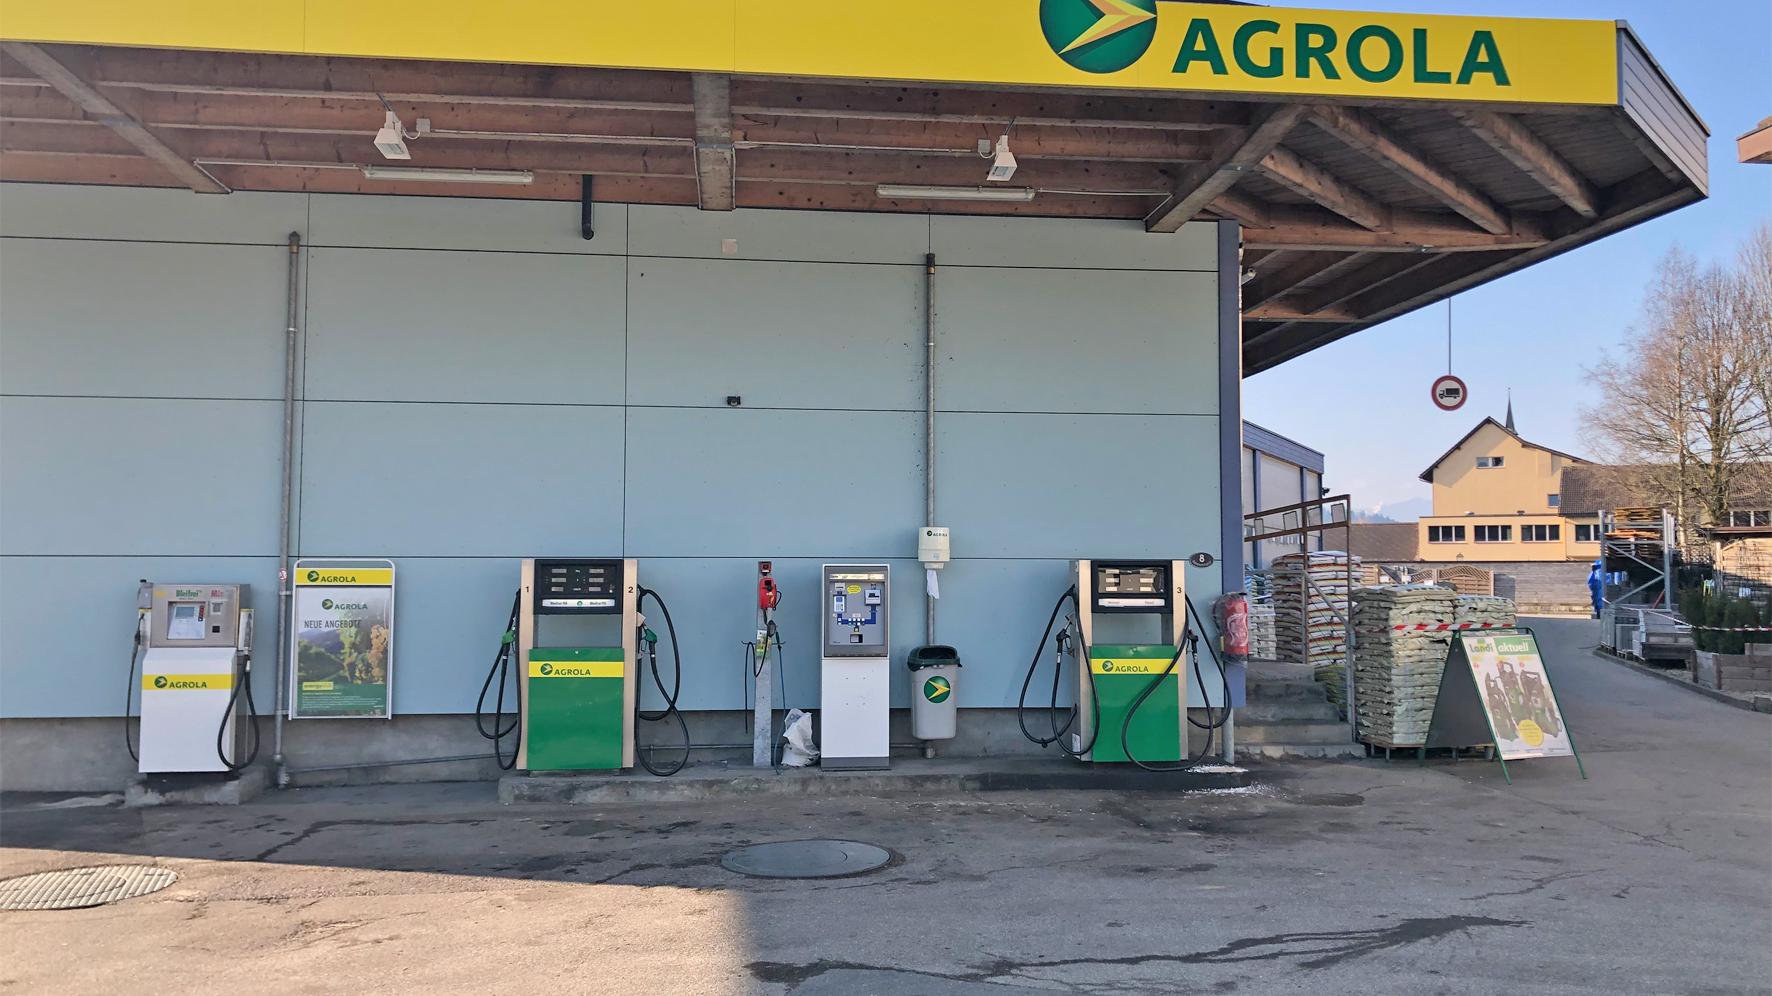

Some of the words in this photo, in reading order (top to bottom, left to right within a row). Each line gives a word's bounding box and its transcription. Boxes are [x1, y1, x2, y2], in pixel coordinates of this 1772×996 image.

[1171, 18, 1512, 87] AGROLA
[1199, 554, 1205, 563] 8
[320, 575, 357, 583] AGROLA
[628, 586, 634, 594] 2
[1176, 586, 1182, 594] 3
[304, 619, 323, 629] NEUE
[324, 619, 362, 629] ANGEBOTE
[1497, 641, 1530, 653] aktuell
[553, 668, 591, 676] AGROLA
[1114, 665, 1150, 673] AGROLA
[169, 681, 208, 689] AGROLA
